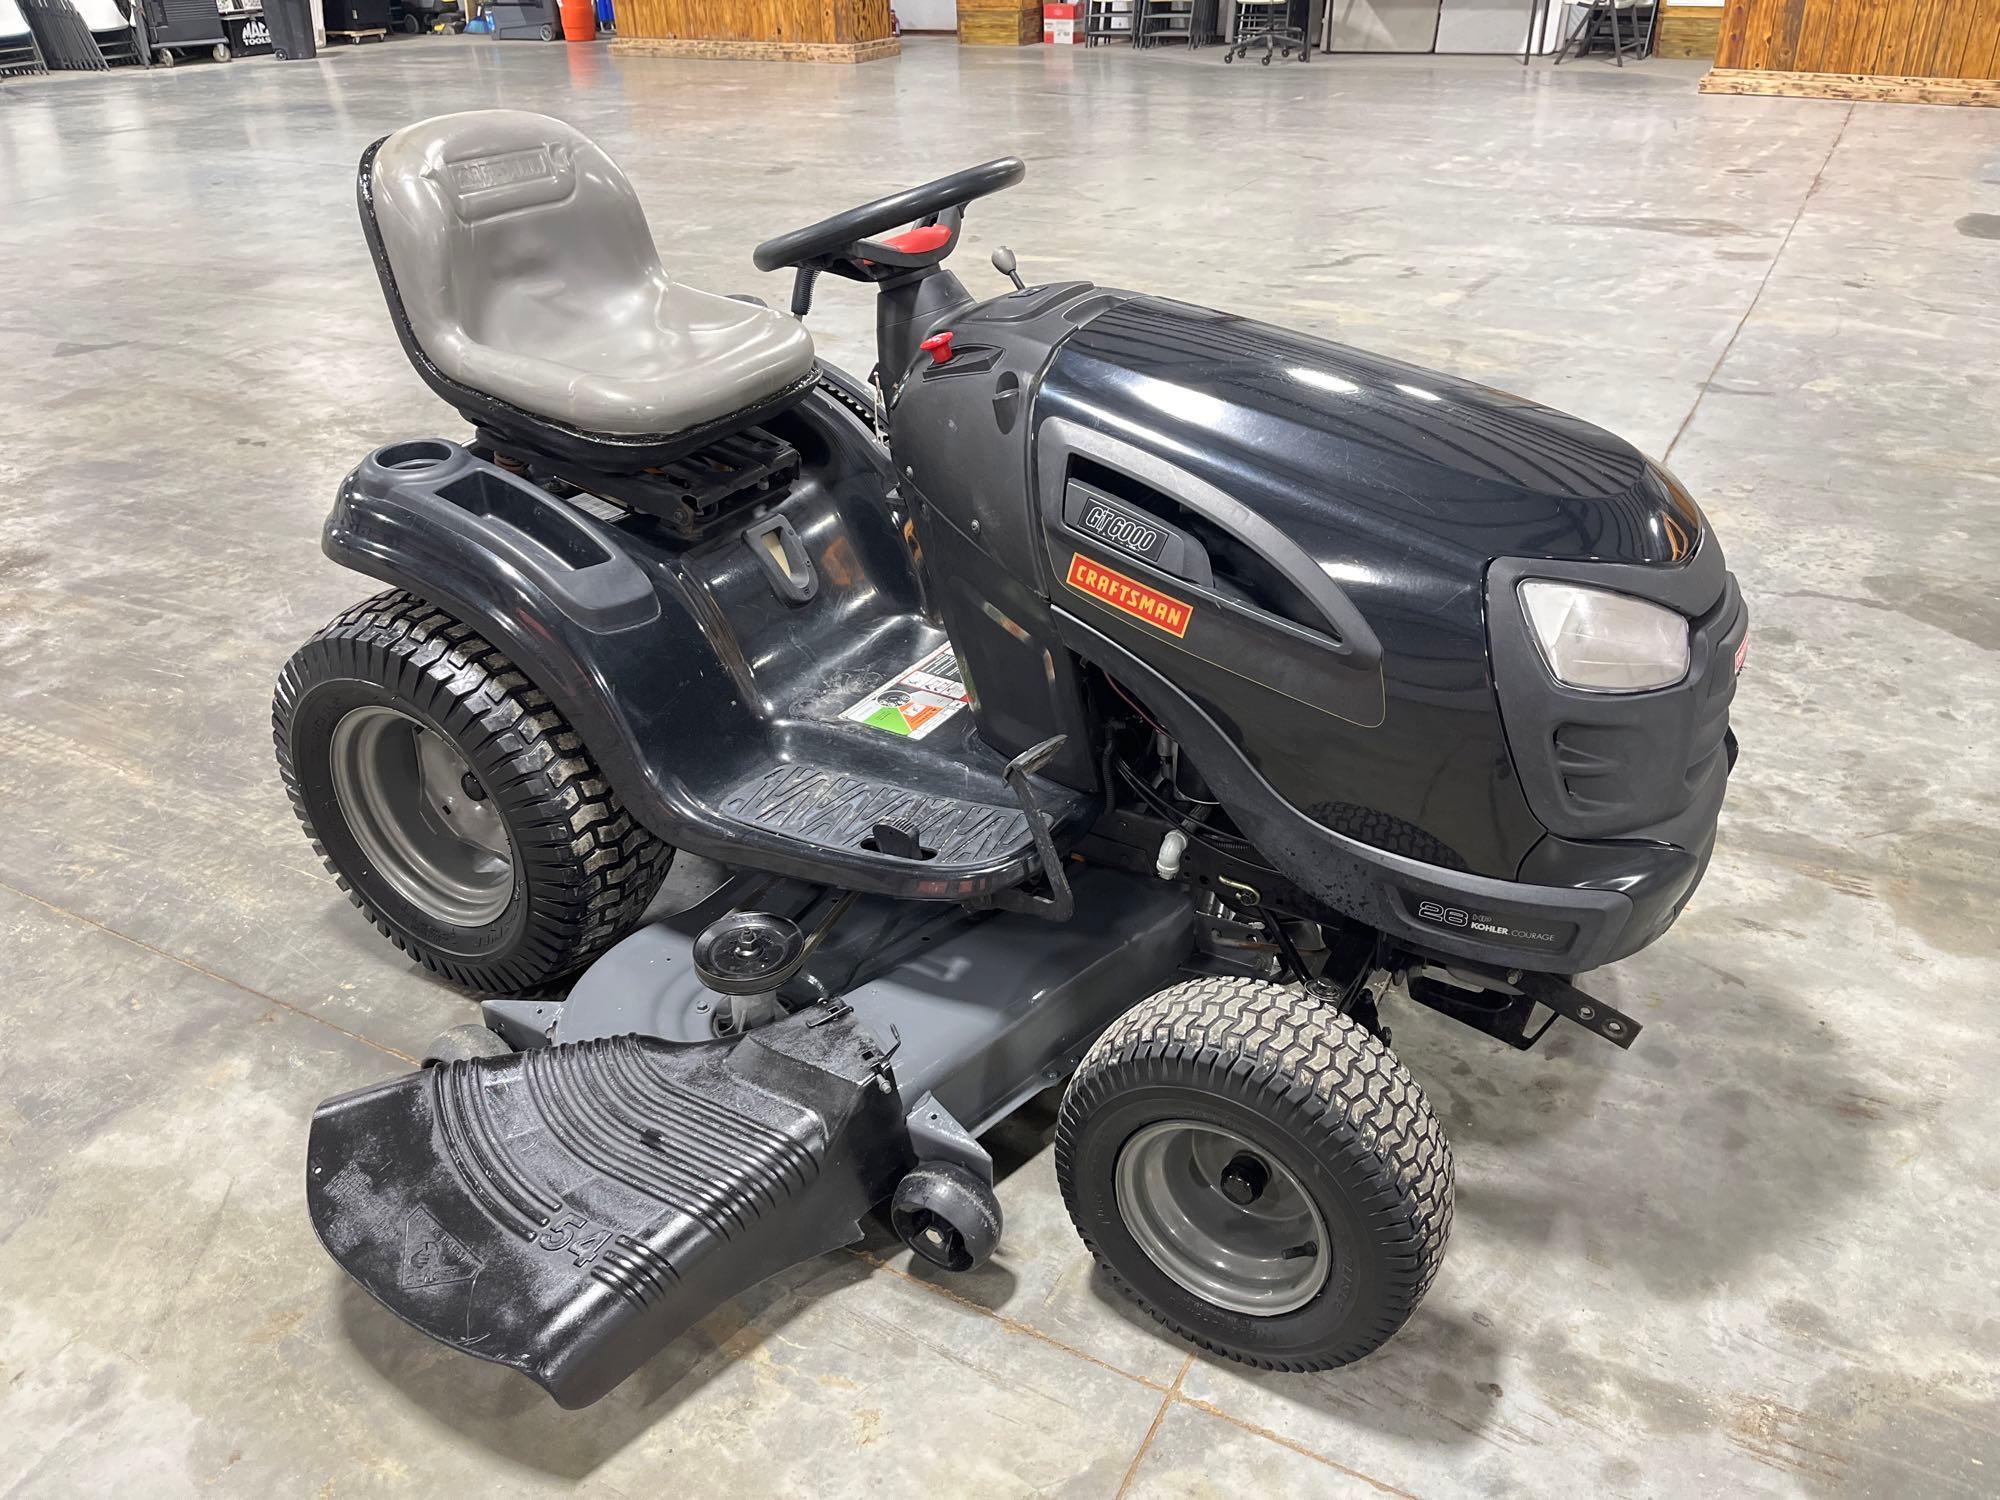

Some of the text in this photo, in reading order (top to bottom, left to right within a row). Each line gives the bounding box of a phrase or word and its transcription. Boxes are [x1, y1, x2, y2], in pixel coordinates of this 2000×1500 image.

[242, 21, 270, 39] MAC
[243, 37, 271, 46] TOOLS
[1076, 565, 1182, 626] CRAFTSMAN
[1471, 921, 1555, 941] KOHLER COURAGE
[540, 1212, 613, 1268] 54
